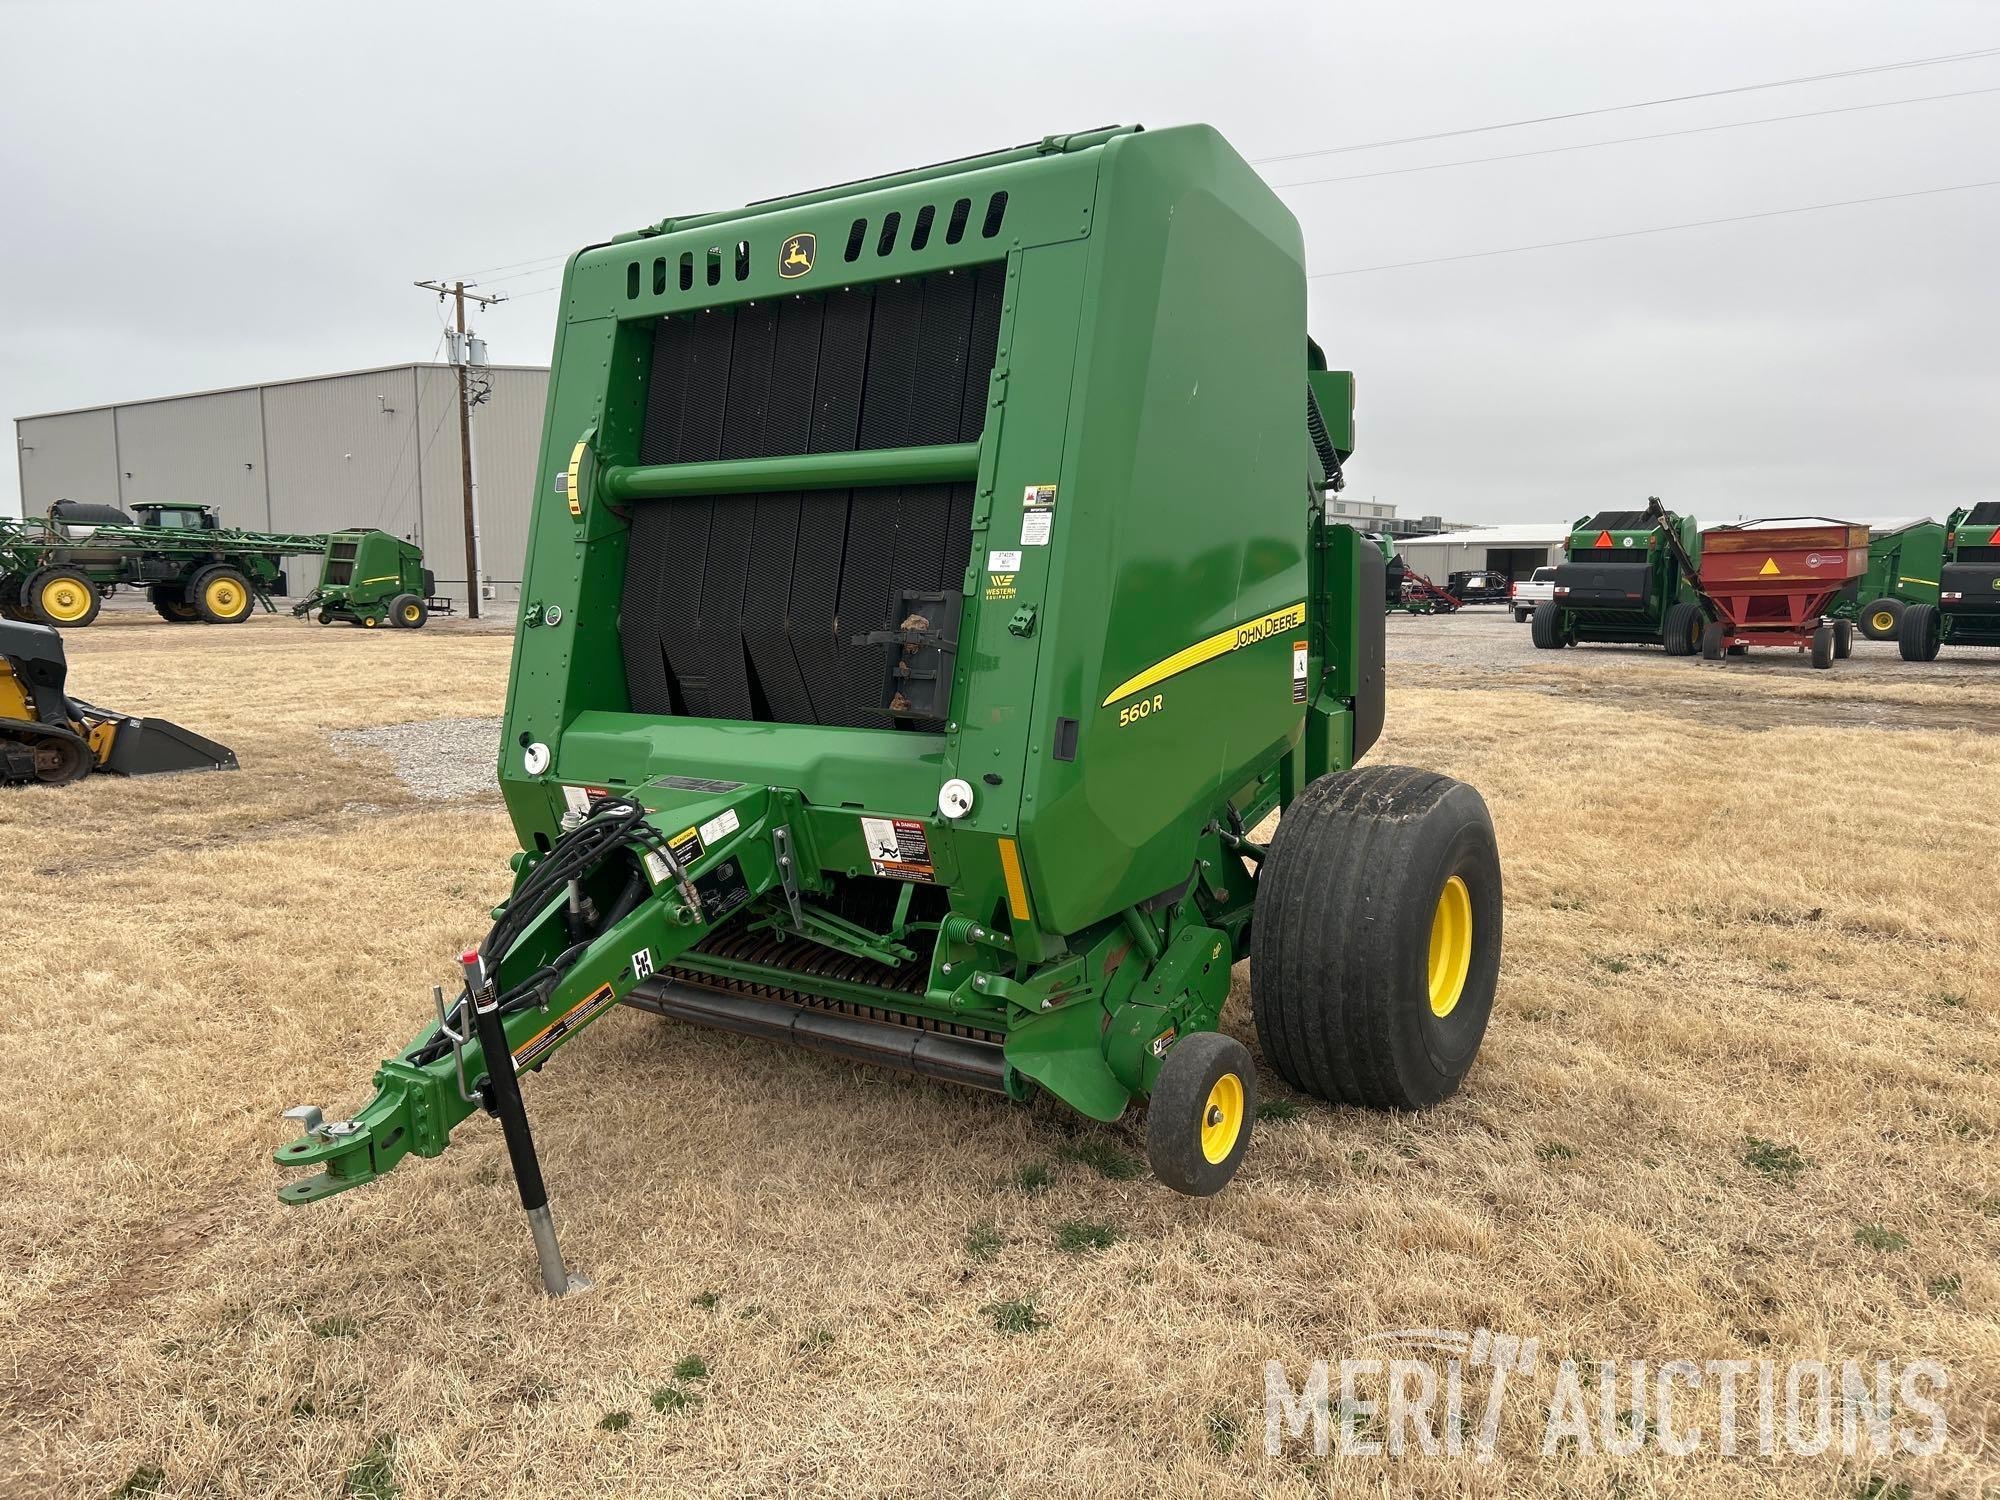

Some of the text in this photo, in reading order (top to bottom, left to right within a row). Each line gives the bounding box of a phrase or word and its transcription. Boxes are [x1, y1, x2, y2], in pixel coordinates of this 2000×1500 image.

[986, 588, 1017, 596] WESTERN
[1232, 611, 1299, 650] JOHN DEERE
[1119, 693, 1164, 728] 560 R
